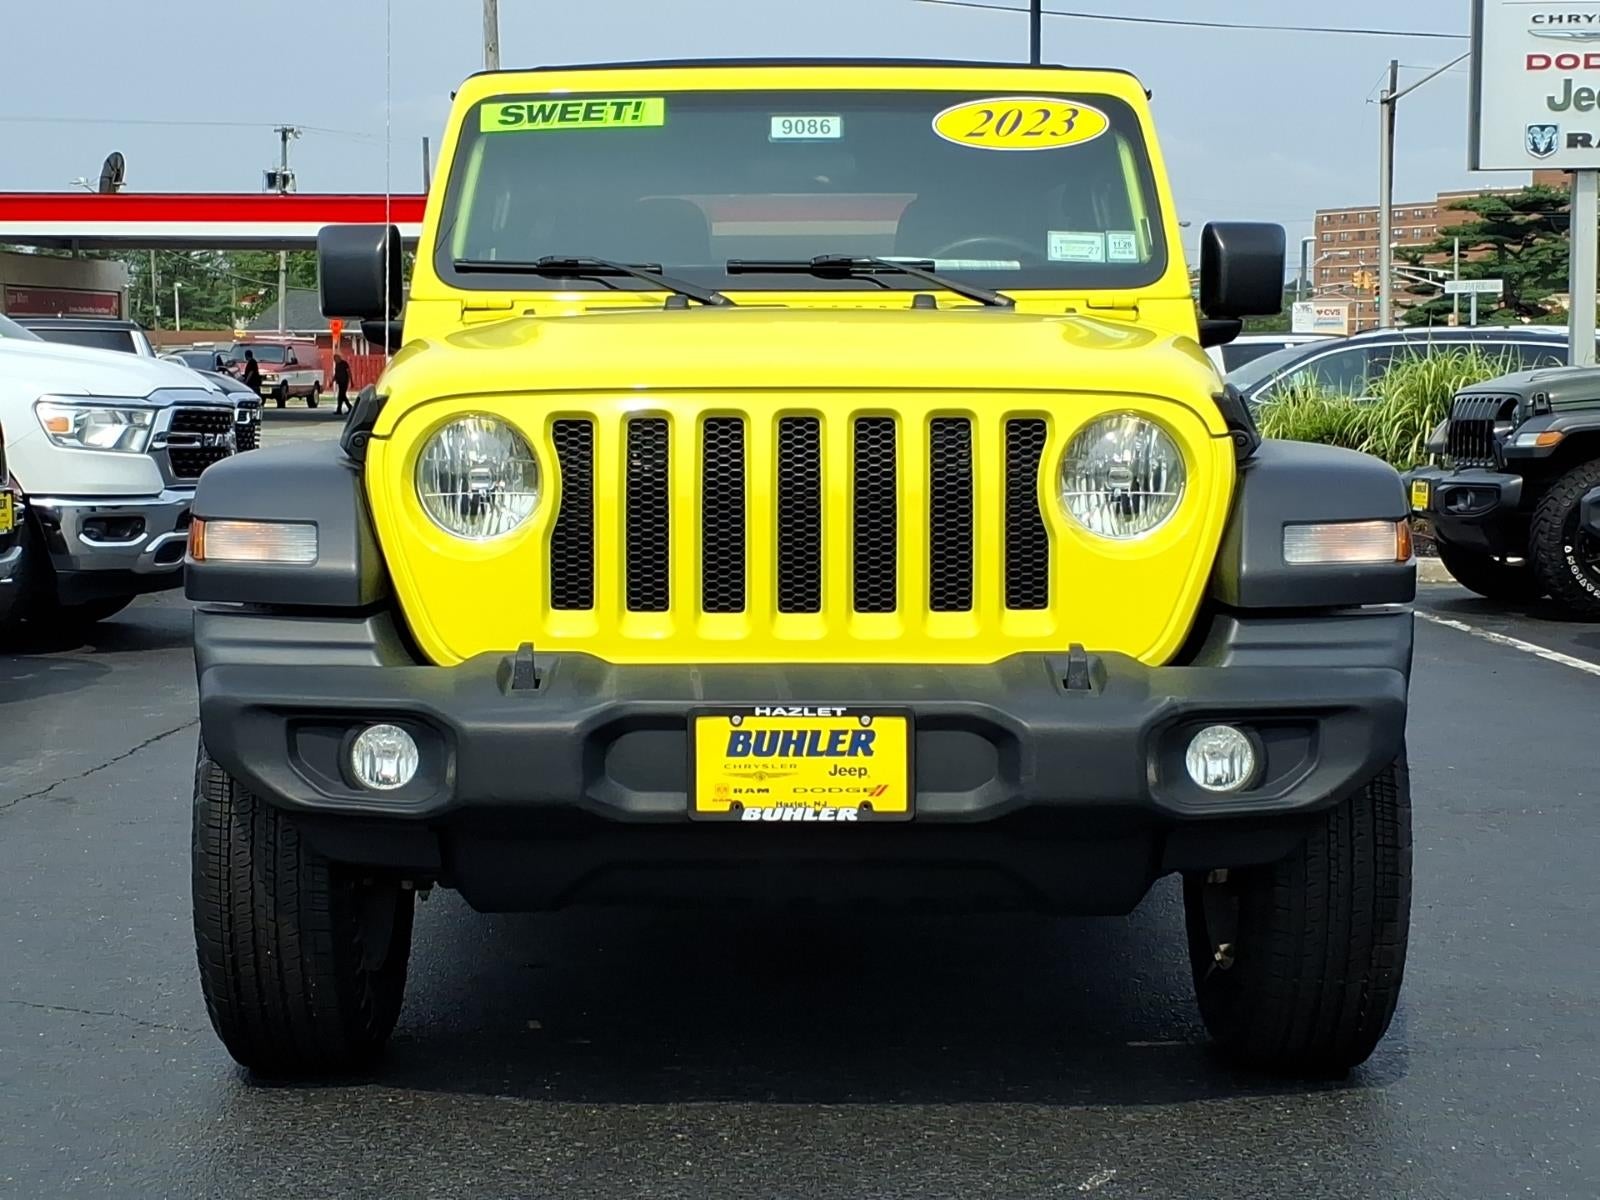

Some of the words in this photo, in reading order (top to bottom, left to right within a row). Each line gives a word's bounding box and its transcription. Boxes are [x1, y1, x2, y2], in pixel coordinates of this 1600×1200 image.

[1531, 14, 1600, 24] CHRY
[1546, 78, 1600, 112] Je
[498, 100, 643, 126] SWEET!
[781, 118, 832, 135] 9086
[965, 108, 1079, 137] 2023
[755, 707, 847, 716] HAZLET
[726, 729, 876, 757] BUHLER
[828, 764, 868, 778] Jeep
[741, 807, 858, 821] BUHLER
